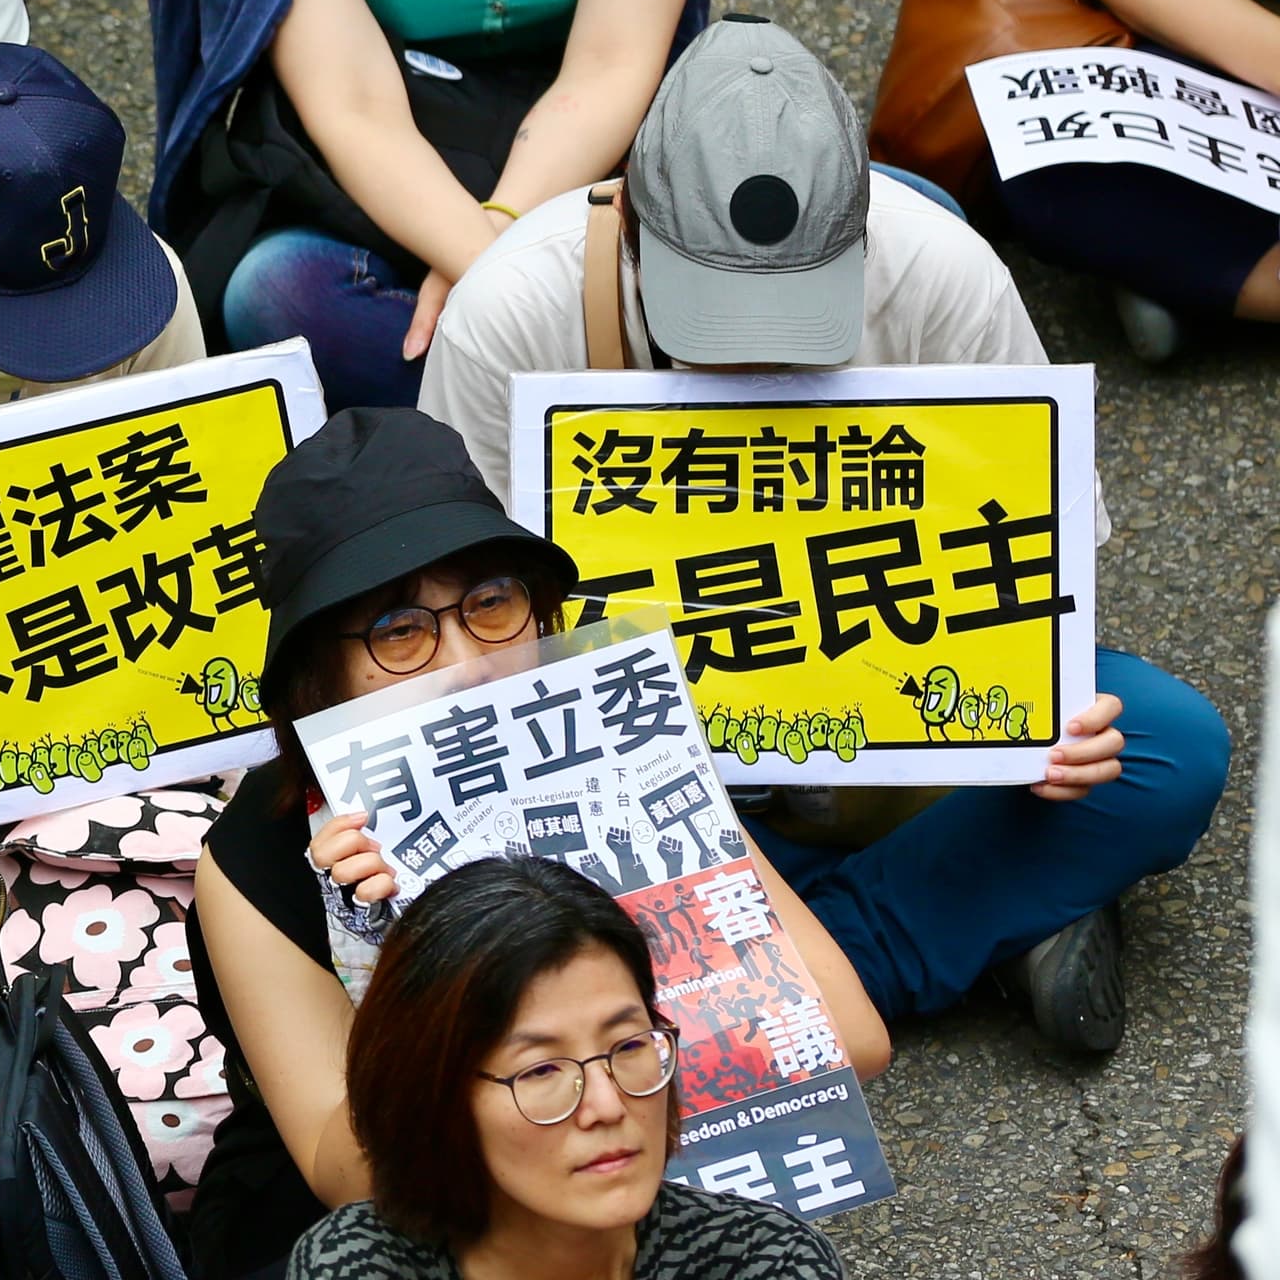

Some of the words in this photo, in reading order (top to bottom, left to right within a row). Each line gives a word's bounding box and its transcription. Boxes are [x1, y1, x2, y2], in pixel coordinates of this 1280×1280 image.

[571, 425, 926, 516] 沒有討論
[326, 648, 688, 831] 有害立委
[635, 750, 672, 776] Harmful
[639, 762, 683, 791] Legislator
[454, 797, 483, 823] Violent
[510, 790, 584, 807] Worst-Legislator
[458, 804, 495, 839] Legislator
[655, 965, 750, 1004] xamination
[680, 1118, 737, 1146] eedom
[737, 1111, 752, 1128] &
[750, 1083, 849, 1124] Democracy
